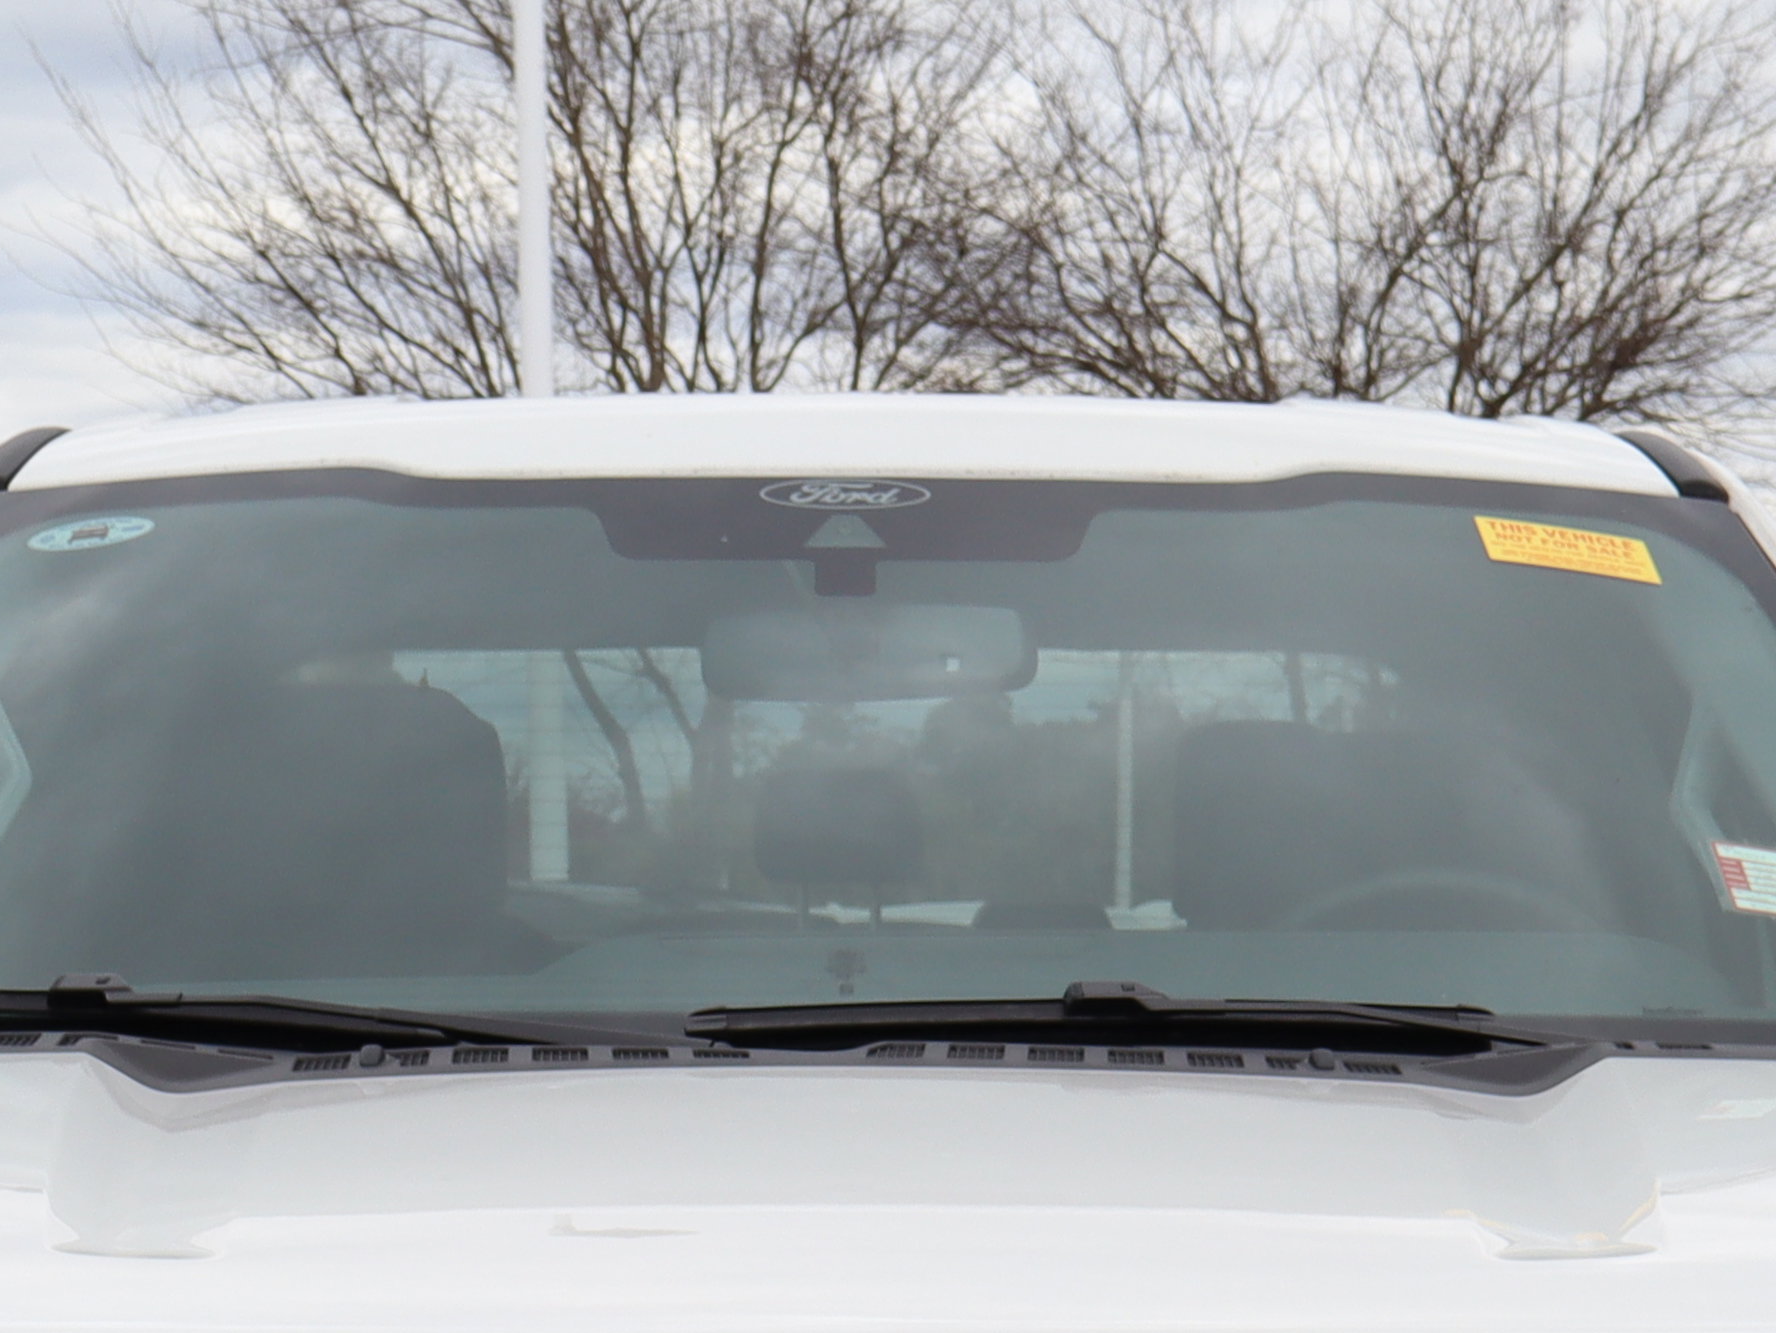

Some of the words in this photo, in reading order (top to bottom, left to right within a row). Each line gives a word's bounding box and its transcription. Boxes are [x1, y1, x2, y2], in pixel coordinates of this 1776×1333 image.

[790, 482, 900, 504] Ford
[1487, 521, 1537, 535] THIS
[1542, 528, 1636, 551] VEHICLE
[1495, 532, 1533, 543] NOT
[1540, 538, 1579, 550] FOR
[1586, 546, 1634, 559] SALE
